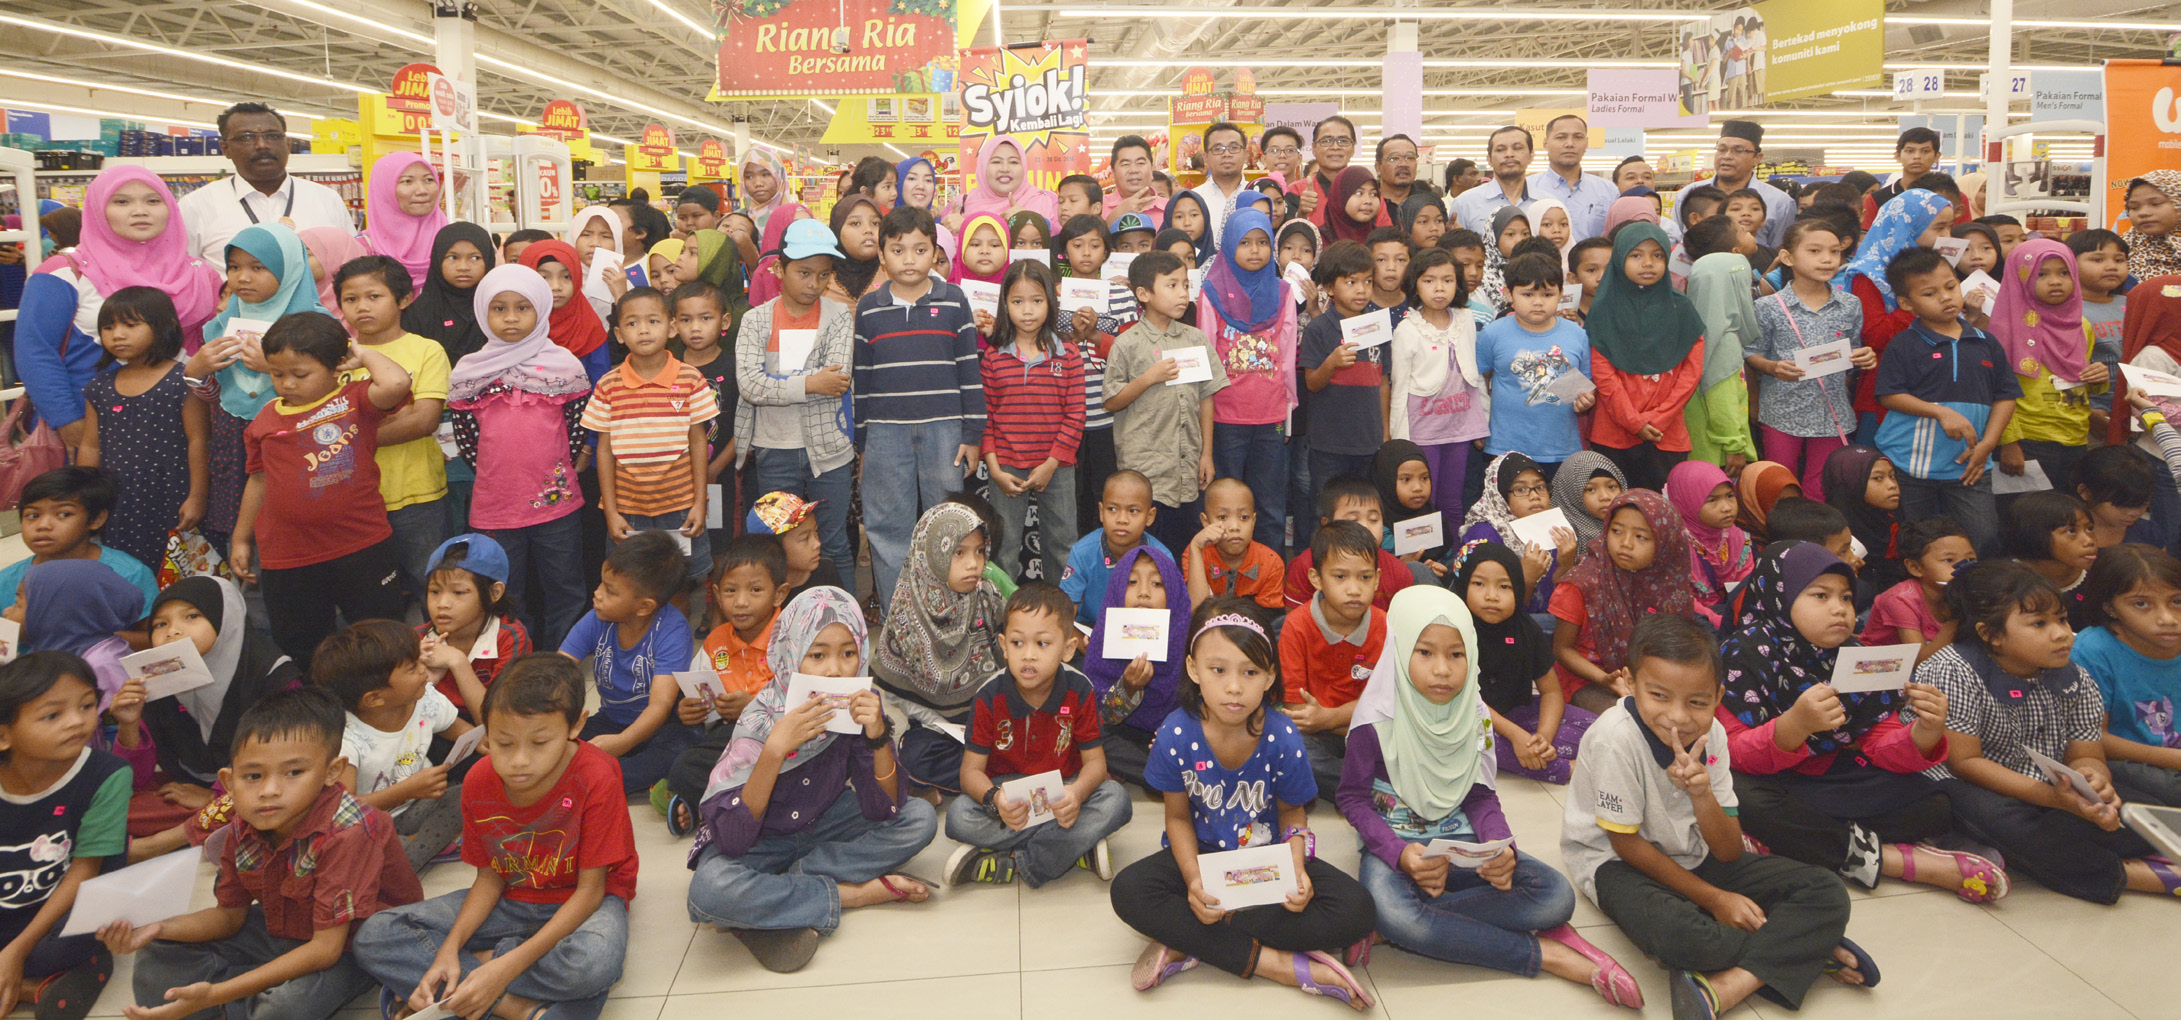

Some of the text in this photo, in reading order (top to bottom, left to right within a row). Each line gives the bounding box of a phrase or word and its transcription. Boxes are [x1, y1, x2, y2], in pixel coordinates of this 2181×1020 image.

[756, 17, 916, 54] Riang Ria
[1772, 18, 1878, 50] Bertekad menyokong
[1771, 41, 1840, 65] komuniti kami
[789, 55, 886, 75] Bersama
[408, 71, 428, 82] Leb
[1189, 73, 1207, 83] Lebih
[395, 80, 430, 97] JIMA
[1184, 82, 1213, 94] JIMAT
[1899, 77, 1913, 94] 28
[1924, 76, 1938, 91] 28
[2012, 77, 2026, 92] 27
[963, 65, 1085, 133] Syiok!
[1591, 92, 1630, 102] Pakaian
[1632, 92, 1666, 102] Formal
[2036, 91, 2102, 100] Pakaian Formal
[405, 100, 431, 110] Promo
[1176, 99, 1221, 112] Riang Ria
[1231, 99, 1261, 110] Riang Ria
[1591, 104, 1645, 113] Ladies Formal
[2036, 101, 2083, 110] Men's Formal
[553, 106, 572, 116] Lebih
[545, 115, 579, 128] JIMAT
[1010, 112, 1083, 132] Kembali Lagi
[1277, 120, 1302, 128] Dalam
[1519, 122, 1545, 131] Kasut
[646, 136, 669, 147] JIMAT
[703, 149, 722, 158] JIMAT
[539, 168, 556, 177] KAUN
[1049, 361, 1063, 373] 18
[303, 423, 359, 472] Jeans
[995, 719, 1014, 750] 3
[1597, 800, 1624, 814] LAYER
